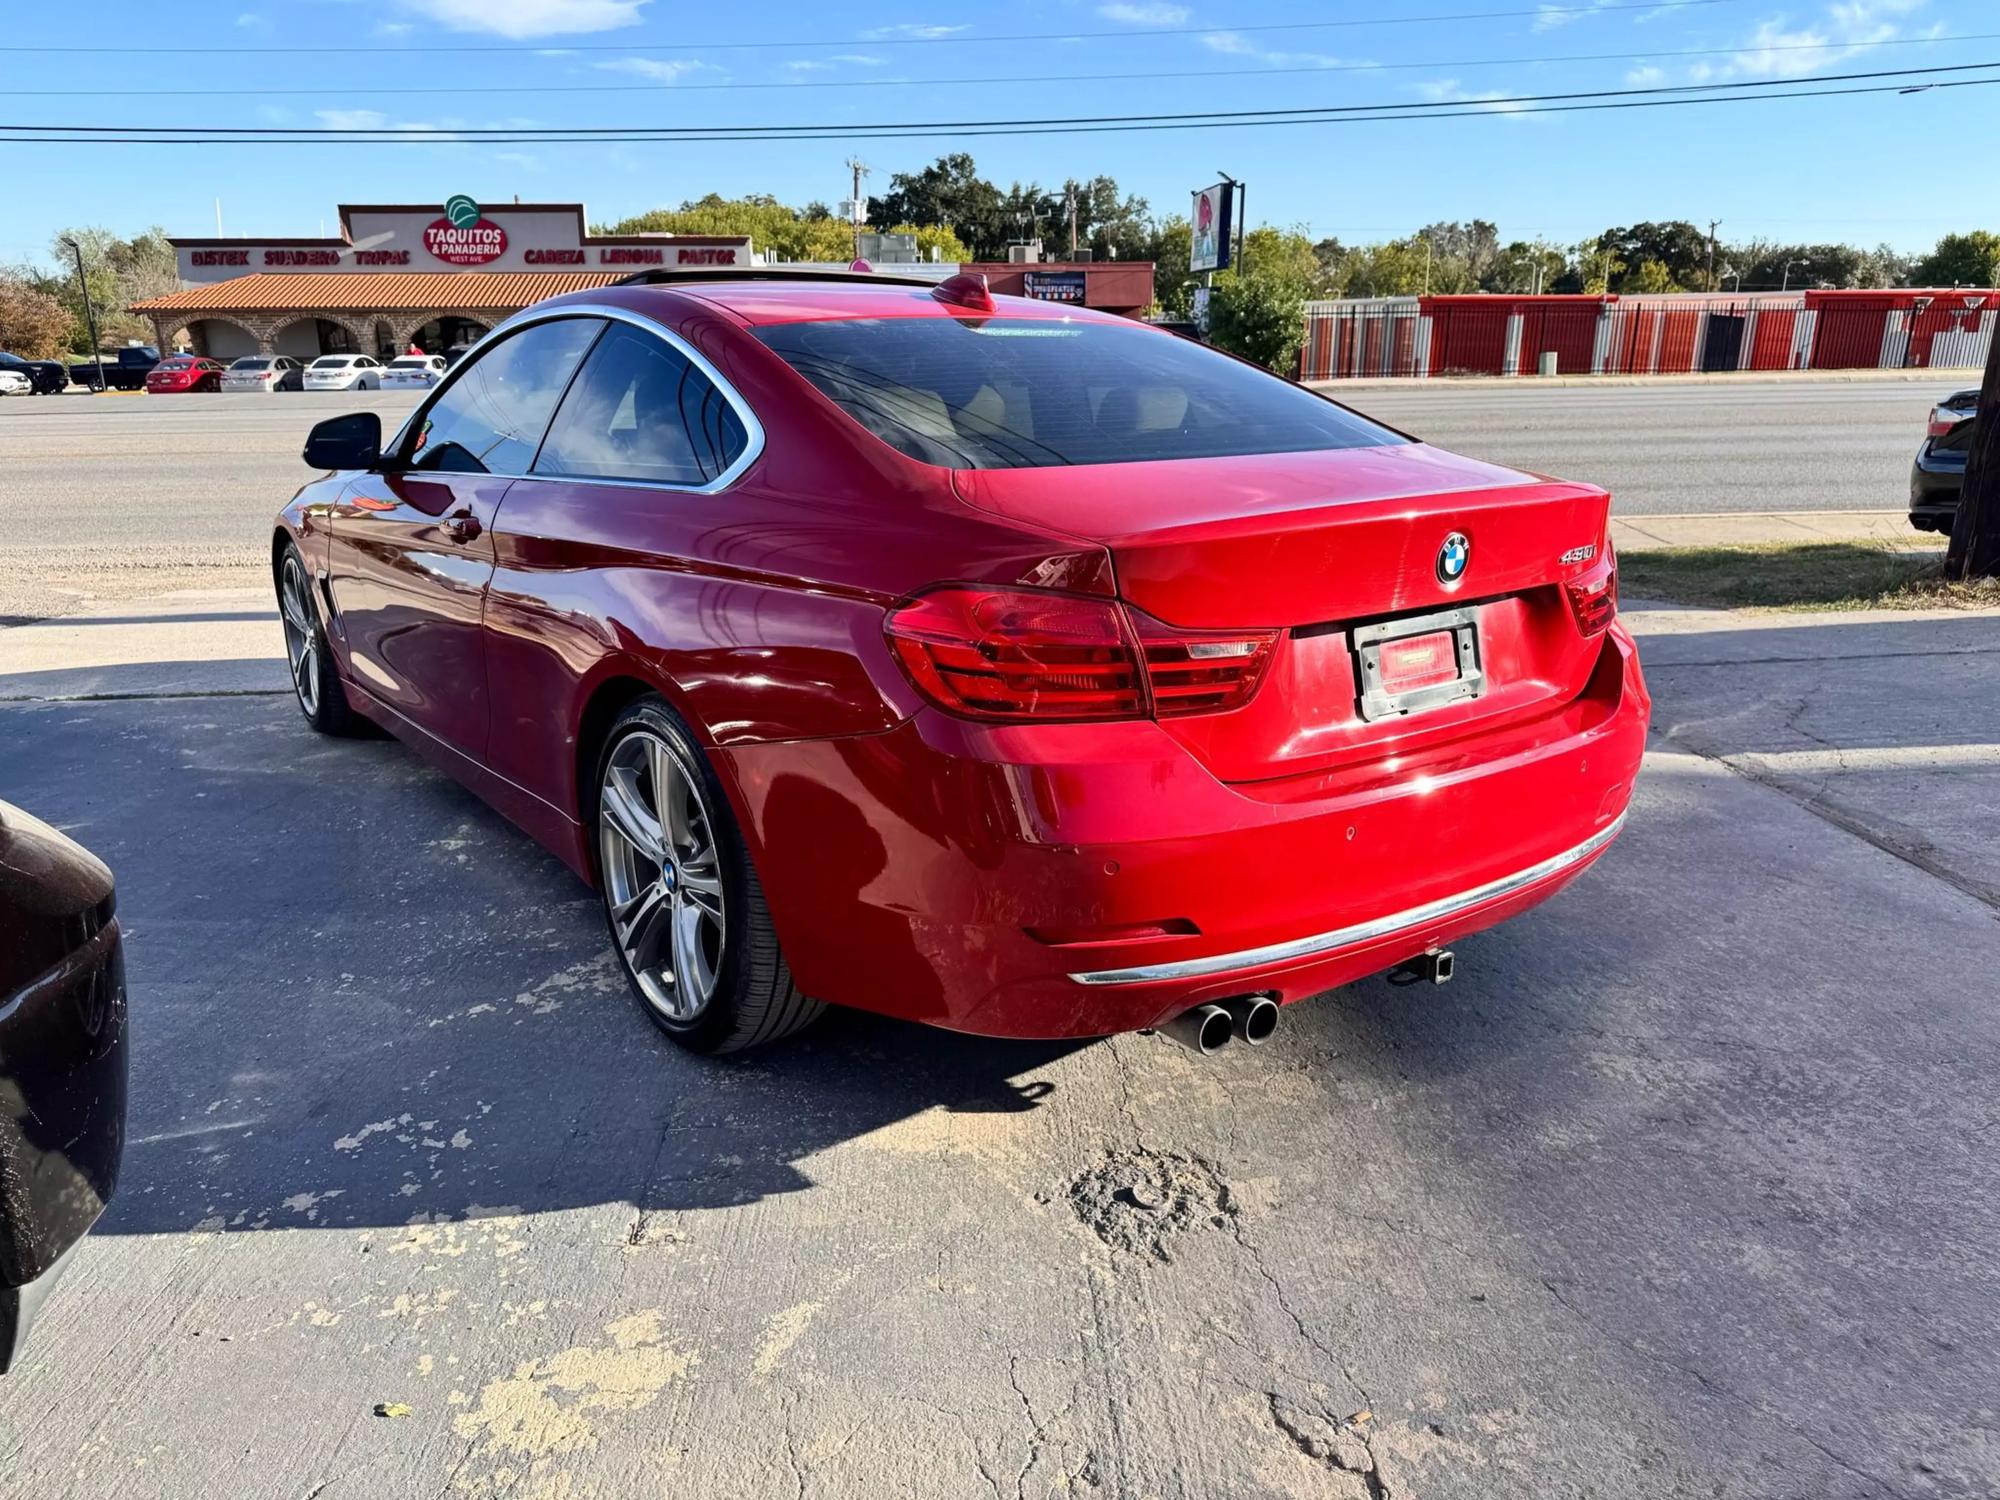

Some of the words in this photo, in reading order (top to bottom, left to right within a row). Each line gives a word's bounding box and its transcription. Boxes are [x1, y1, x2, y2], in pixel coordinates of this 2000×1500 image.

[427, 228, 502, 244] TAQUITOS
[432, 244, 440, 255] &
[441, 244, 501, 255] PANADERIA
[524, 249, 586, 265] CABEZA
[600, 249, 663, 265] LENGUA
[678, 249, 736, 265] PASTOR
[191, 250, 250, 266] BISTEK
[264, 250, 341, 266] SUADERO
[353, 250, 410, 266] TRIPAS
